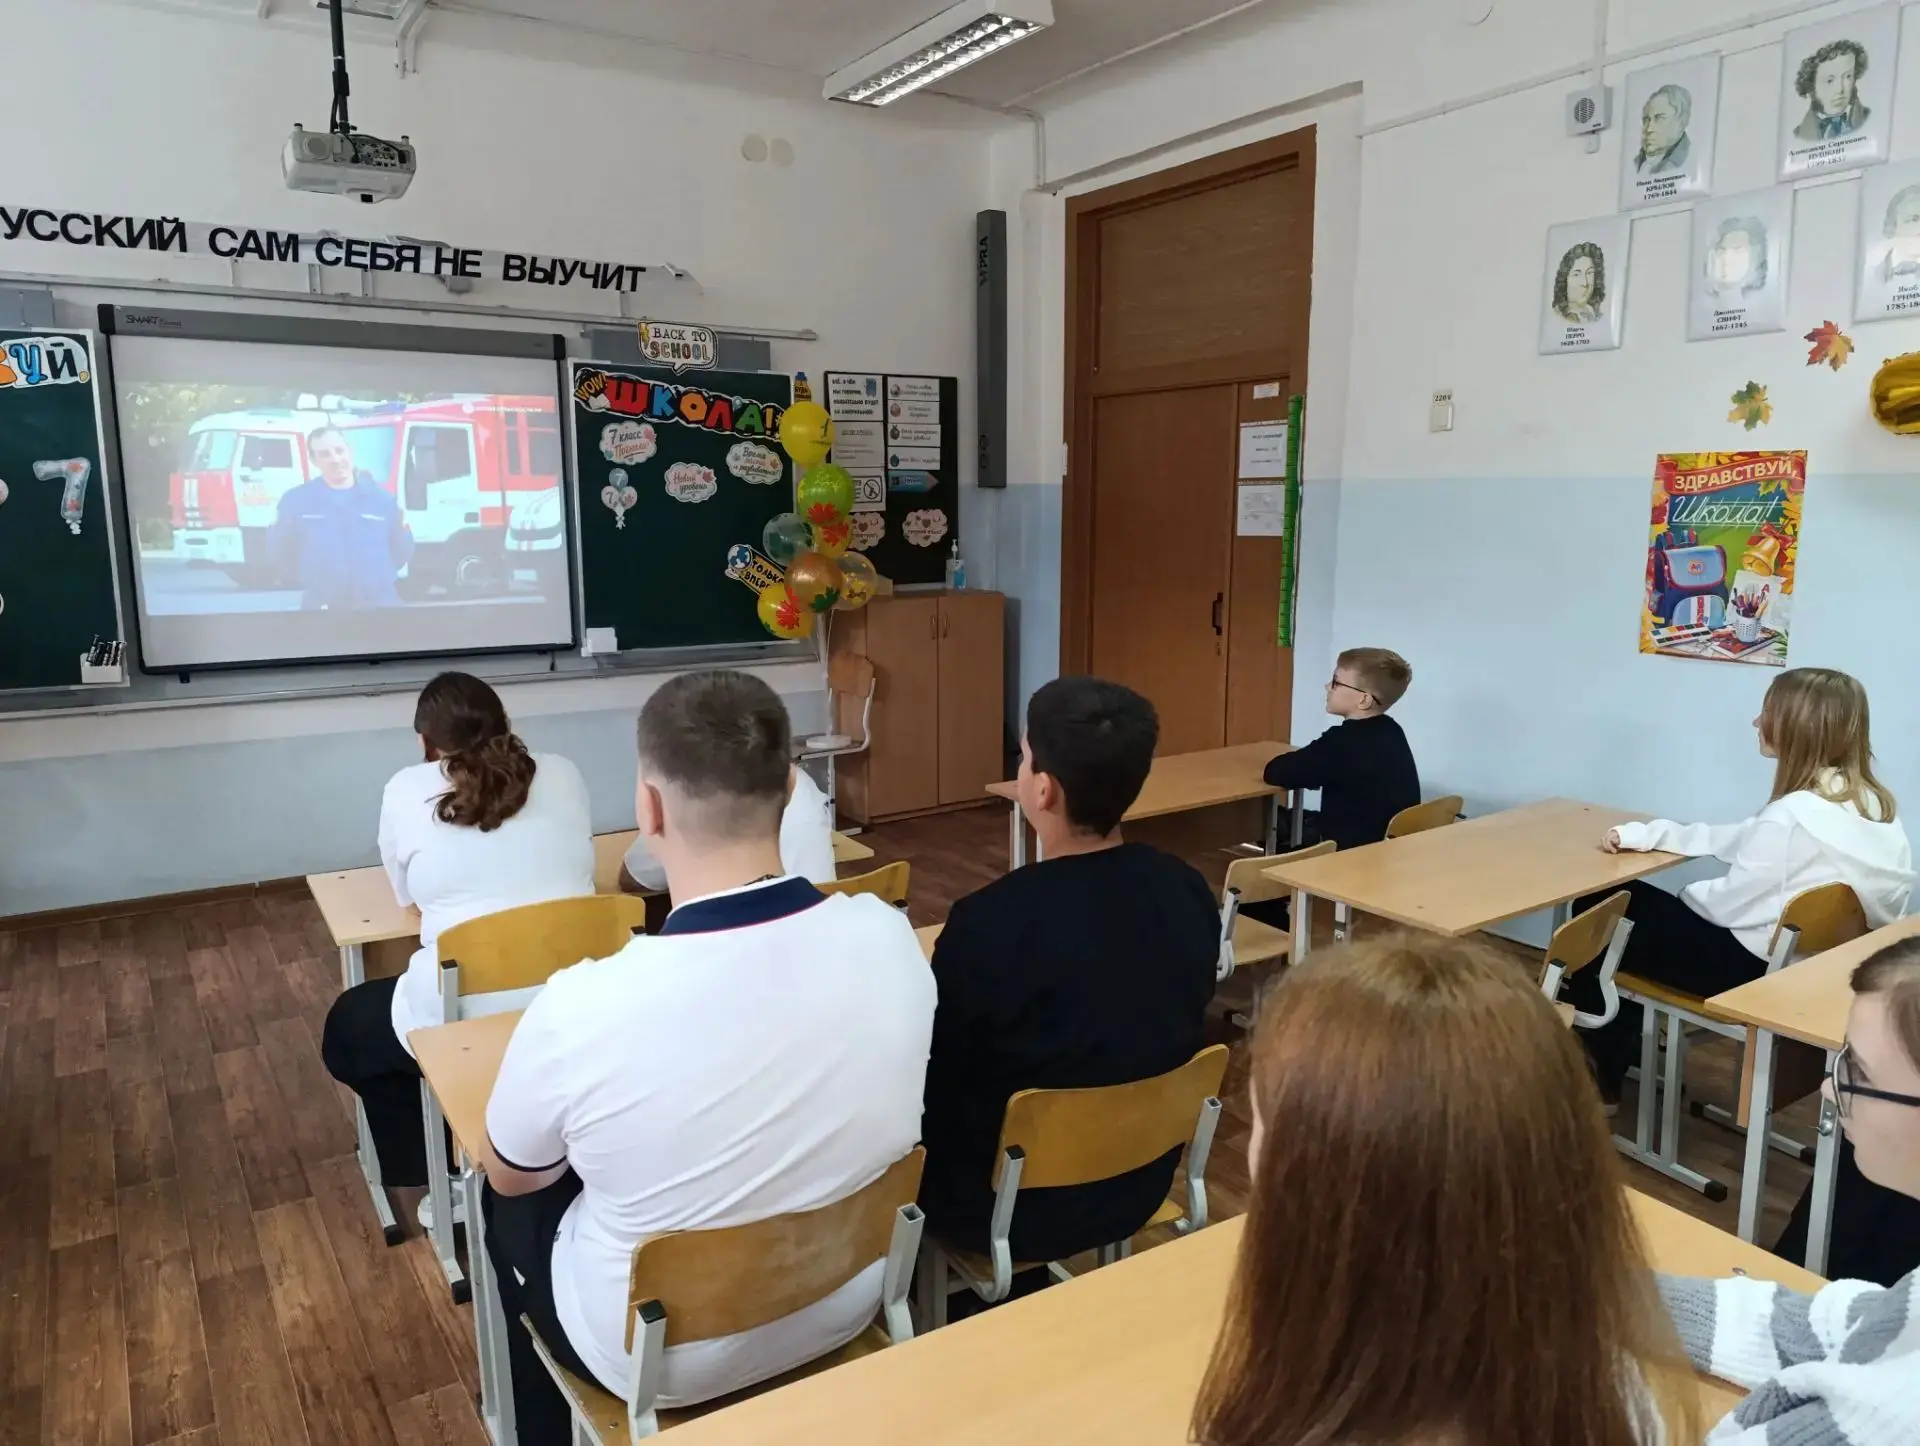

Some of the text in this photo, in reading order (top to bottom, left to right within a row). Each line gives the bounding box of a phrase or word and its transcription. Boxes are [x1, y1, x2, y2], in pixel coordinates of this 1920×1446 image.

[1643, 189, 1677, 200] 1769-1844
[1646, 182, 1675, 193] КРЫЛОВ
[208, 227, 300, 263] САМ
[315, 237, 422, 274] СЕБЯ
[434, 247, 483, 278] НЕ
[502, 254, 647, 292] ВЫУЧИТ
[125, 314, 160, 325] SMART
[1717, 314, 1742, 323] СВИФТ
[653, 326, 707, 342] BACK TO
[649, 341, 710, 361] SCHOOL
[576, 371, 608, 401] WOW!
[604, 377, 775, 436] ШКОЛА!
[608, 429, 642, 444] 7 класс
[1675, 456, 1797, 491] ЗДРАВСТВУЙ,
